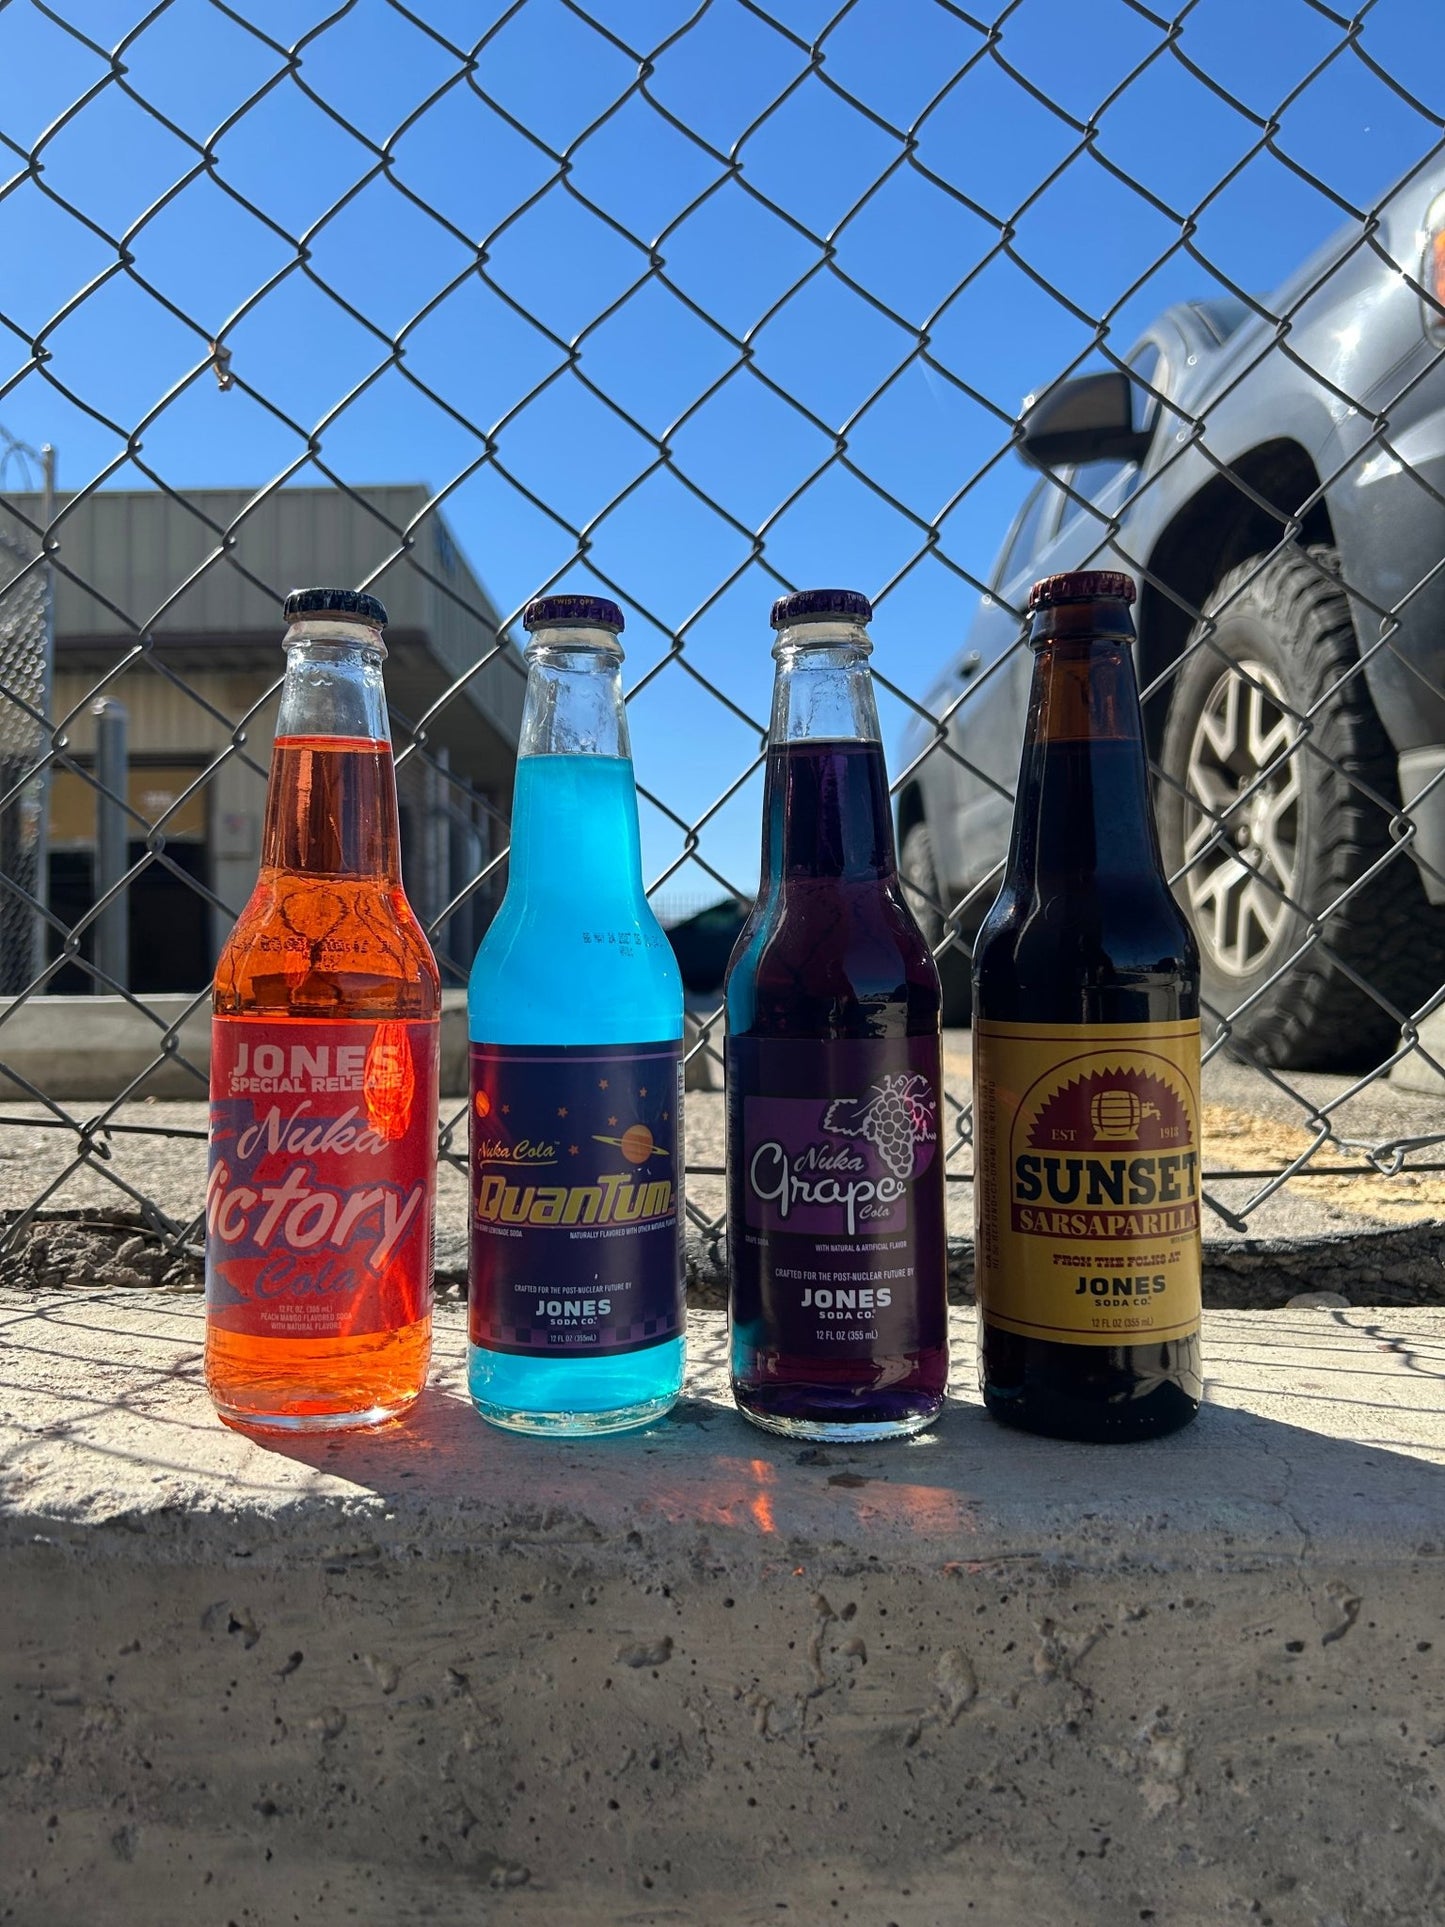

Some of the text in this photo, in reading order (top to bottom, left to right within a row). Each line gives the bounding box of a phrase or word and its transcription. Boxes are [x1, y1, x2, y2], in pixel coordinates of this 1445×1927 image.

[553, 598, 576, 606] TWIST
[233, 1042, 401, 1079] JONES
[231, 1077, 306, 1094] SPECIAL
[237, 1100, 391, 1160] Nuka
[1051, 1128, 1077, 1141] EST
[478, 1139, 555, 1160] Nuka Cola
[793, 1146, 864, 1172] Nuka
[1015, 1150, 1198, 1205] SUNSET
[750, 1142, 907, 1236] Grape
[858, 1203, 890, 1220] Cola
[1019, 1206, 1197, 1236] SARSAPARILLA
[569, 1230, 599, 1240] NATURALLY
[600, 1228, 626, 1238] FLAVORED
[626, 1226, 637, 1235] WITH
[815, 1244, 829, 1252] WITH
[830, 1244, 855, 1252] NATURAL
[861, 1242, 889, 1252] ARTIFICIAL
[889, 1240, 907, 1249] FLAVOR
[1052, 1251, 1181, 1268] FROM THE FOLKS AT
[254, 1255, 359, 1299] Cola
[775, 1267, 915, 1282] CRAFTED FOR THE POST-NUCLEAR FUTURE BY
[514, 1281, 632, 1294] CRAFTED FOR THE POST-NUCLEAR FUTURE BY
[1075, 1274, 1166, 1296] JONES
[801, 1288, 892, 1309] JONES
[1095, 1299, 1129, 1307] SODA
[535, 1299, 612, 1317] JONES
[819, 1311, 853, 1320] SODA
[303, 1312, 335, 1322] FLAVORED
[550, 1318, 578, 1326] SODA
[1091, 1318, 1100, 1328] 12
[1102, 1319, 1111, 1328] FL
[1112, 1318, 1122, 1328] OZ
[287, 1322, 313, 1330] NATURAL
[550, 1334, 556, 1343] 12
[558, 1334, 564, 1343] FL
[816, 1328, 878, 1341] 12 FL OZ (355 mL)
